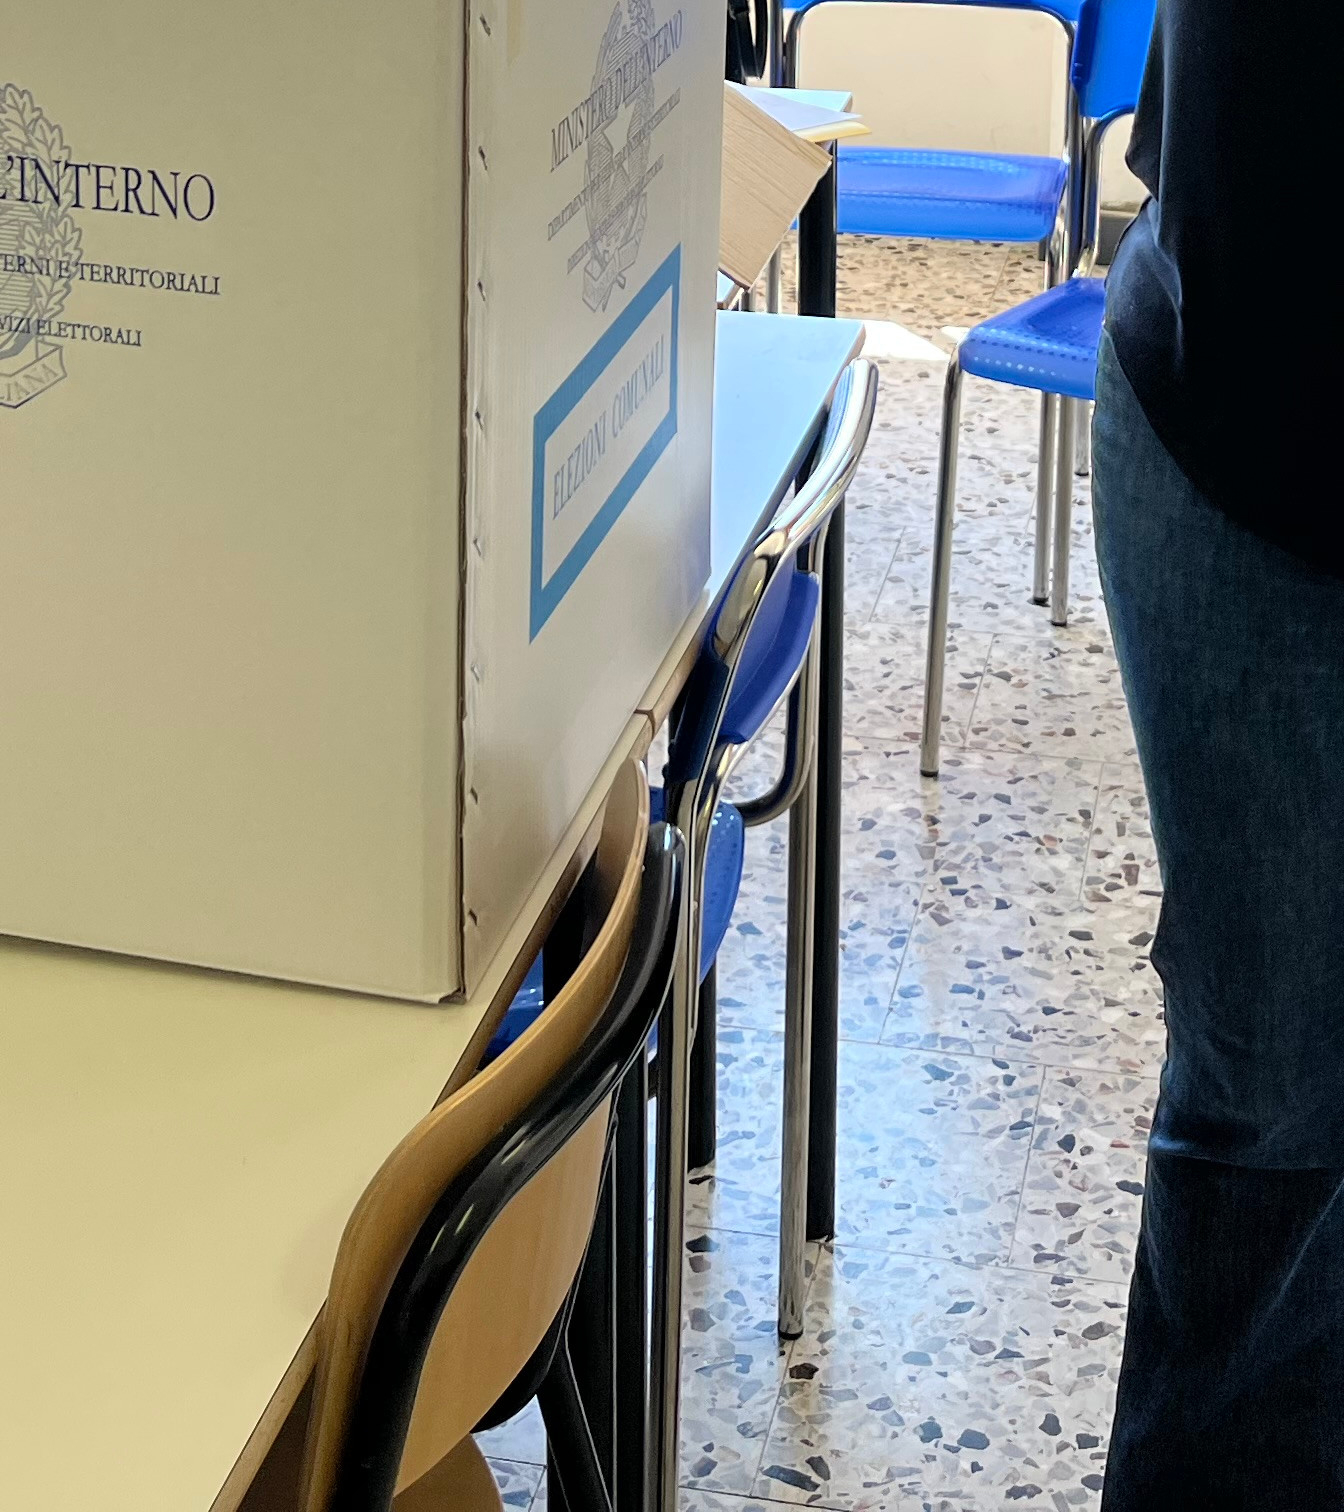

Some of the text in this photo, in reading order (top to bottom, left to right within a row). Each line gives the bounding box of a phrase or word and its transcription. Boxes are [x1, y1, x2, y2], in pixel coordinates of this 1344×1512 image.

[56, 257, 73, 280] E
[74, 260, 221, 296] TERRITORIALI
[35, 316, 142, 347] ELETTORALI
[552, 410, 607, 520] ELEZIONI
[612, 333, 665, 438] COMUNALI
